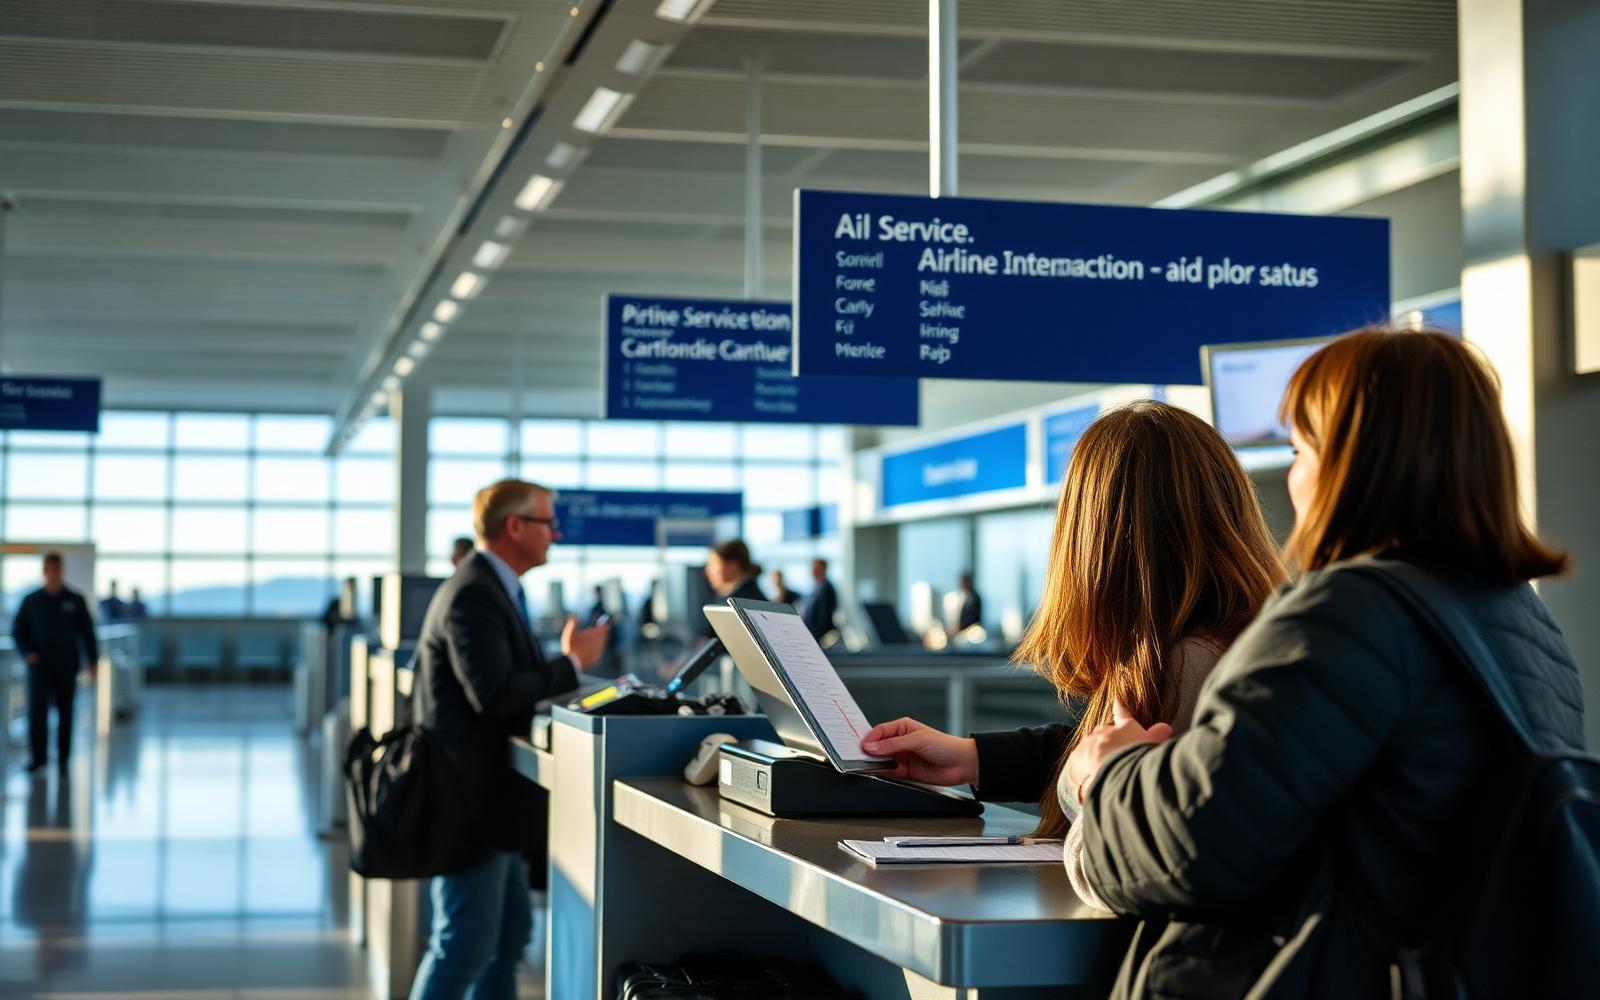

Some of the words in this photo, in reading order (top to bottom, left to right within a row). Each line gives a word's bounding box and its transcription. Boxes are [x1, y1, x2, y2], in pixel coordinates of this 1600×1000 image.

[878, 215, 975, 244] Service.
[917, 247, 999, 276] Airline
[1165, 256, 1203, 284] aid
[1207, 257, 1256, 290] plor
[1259, 262, 1320, 288] satus
